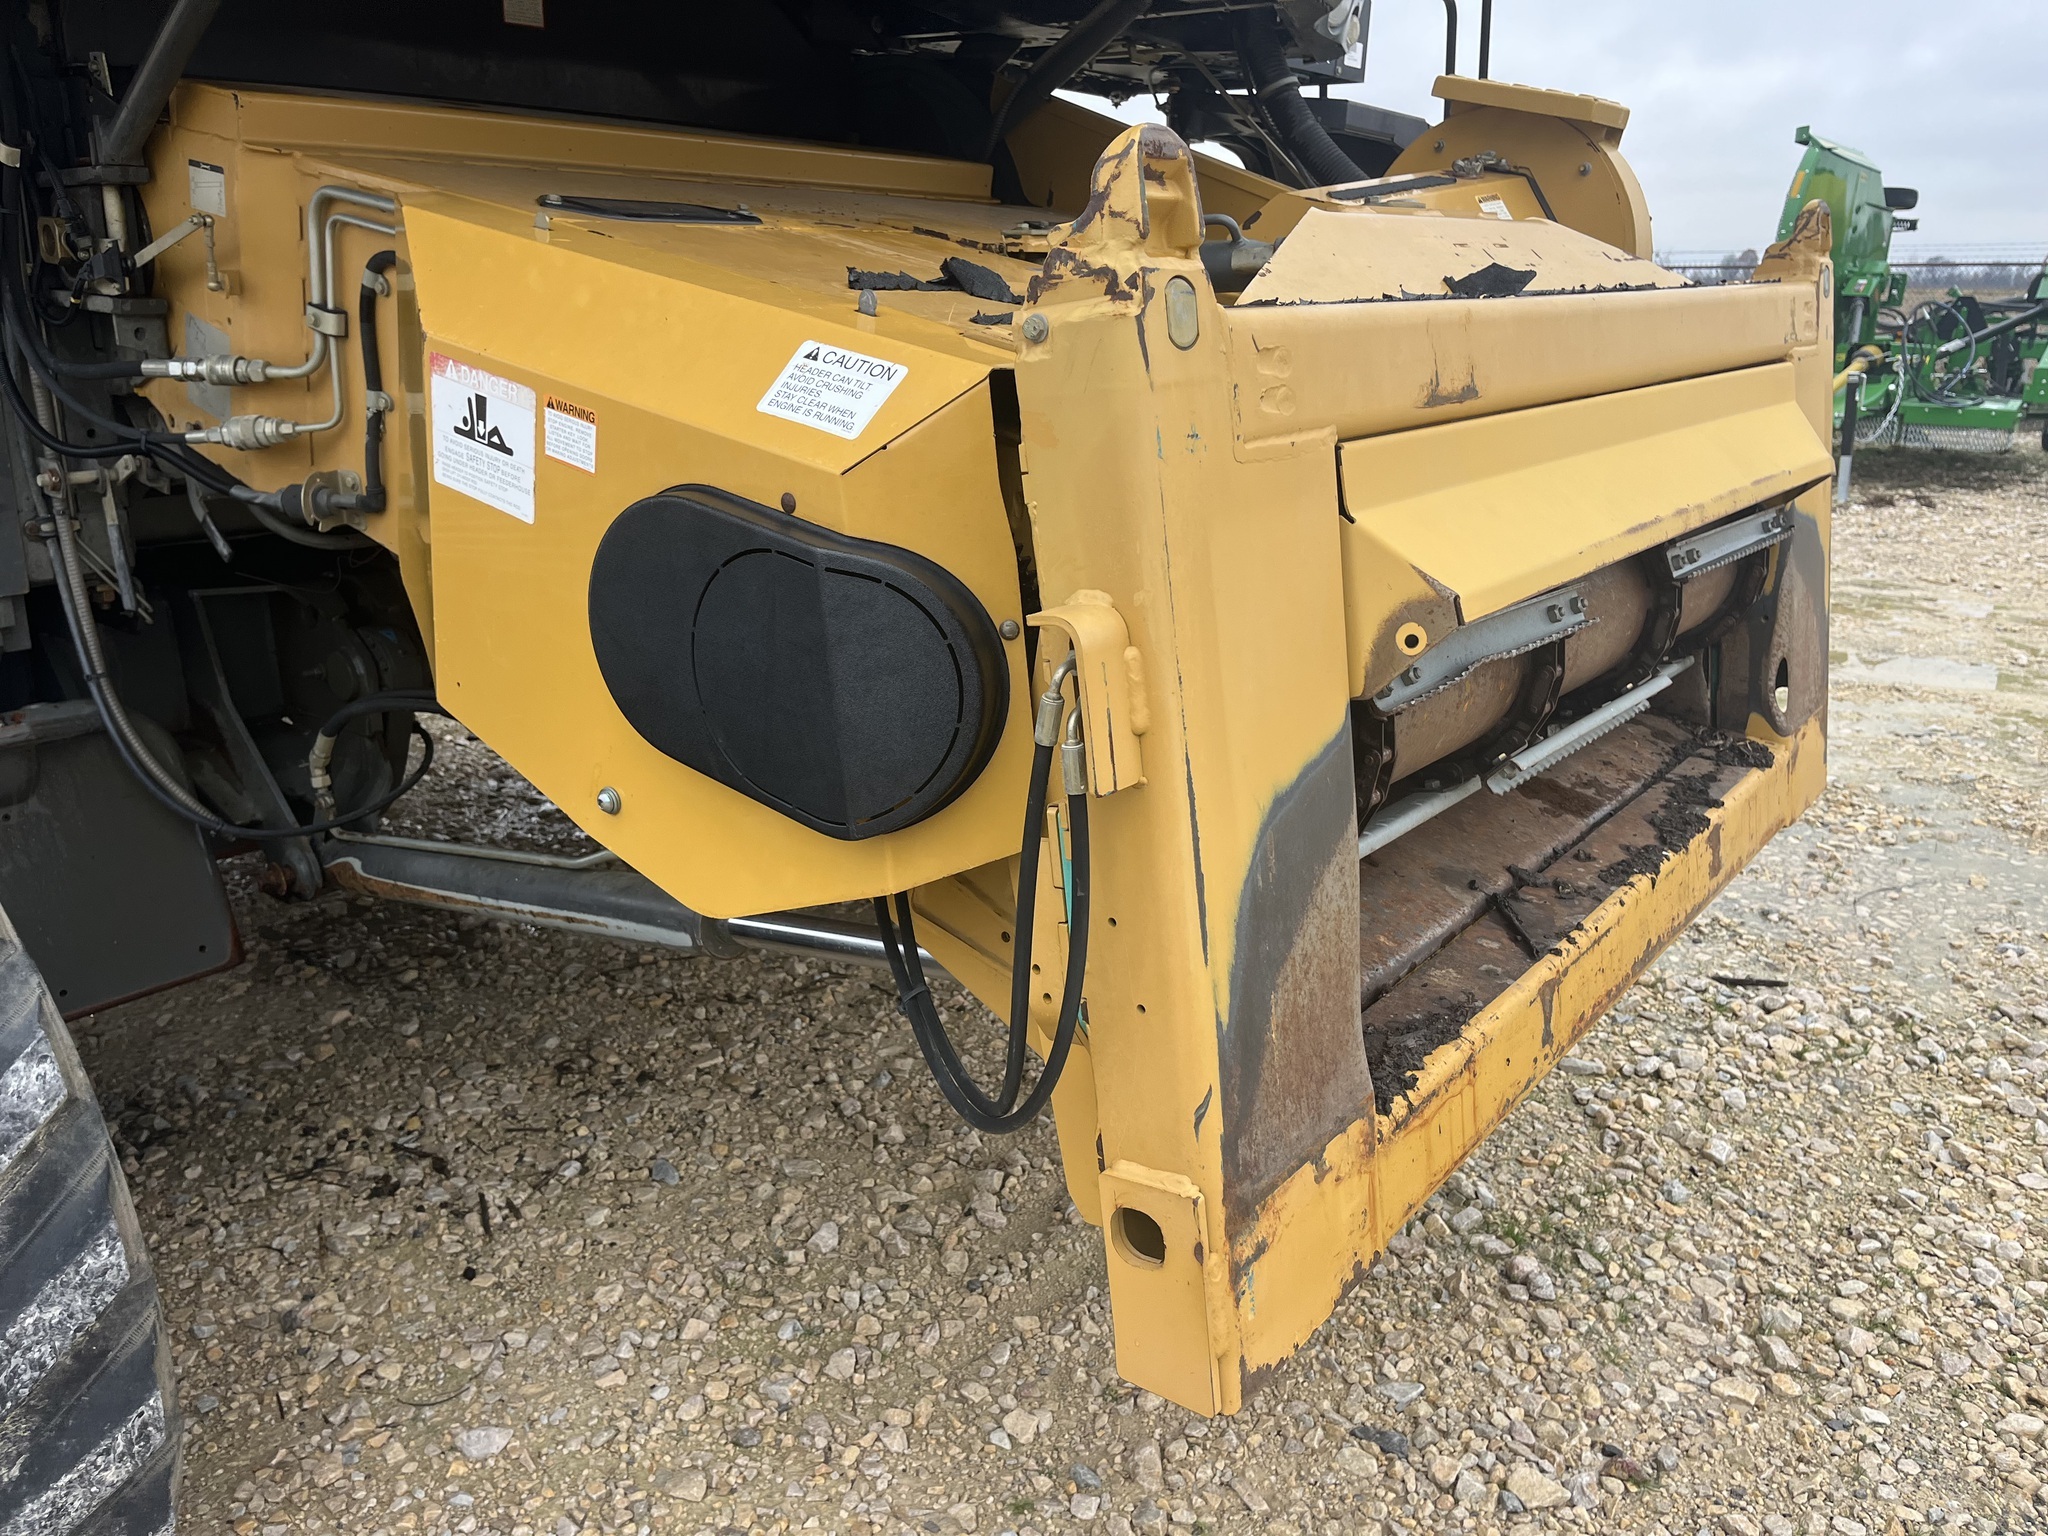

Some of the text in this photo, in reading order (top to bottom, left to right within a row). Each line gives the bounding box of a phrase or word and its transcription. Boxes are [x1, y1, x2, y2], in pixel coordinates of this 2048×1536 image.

[794, 364, 832, 379] HEADER
[832, 374, 853, 386] CAN
[823, 351, 898, 381] CAUTION
[461, 364, 519, 402] DANGER
[788, 372, 863, 400] AVOID CRUSHING
[555, 399, 595, 423] WARNING
[768, 399, 803, 413] ENGINE
[802, 408, 812, 417] IS
[775, 390, 857, 419] STAY CLEAR WHEN
[445, 446, 521, 482] ENGAGE SAFETY STOP BEFORE
[450, 438, 463, 448] AVOID
[464, 444, 484, 457] SERIOUS
[485, 451, 501, 462] INJURY
[510, 463, 525, 474] DEATH
[438, 451, 452, 460] GOING
[453, 456, 468, 468] UNDER
[469, 463, 488, 476] HEADER
[497, 476, 530, 496] FEEDERHOUSE
